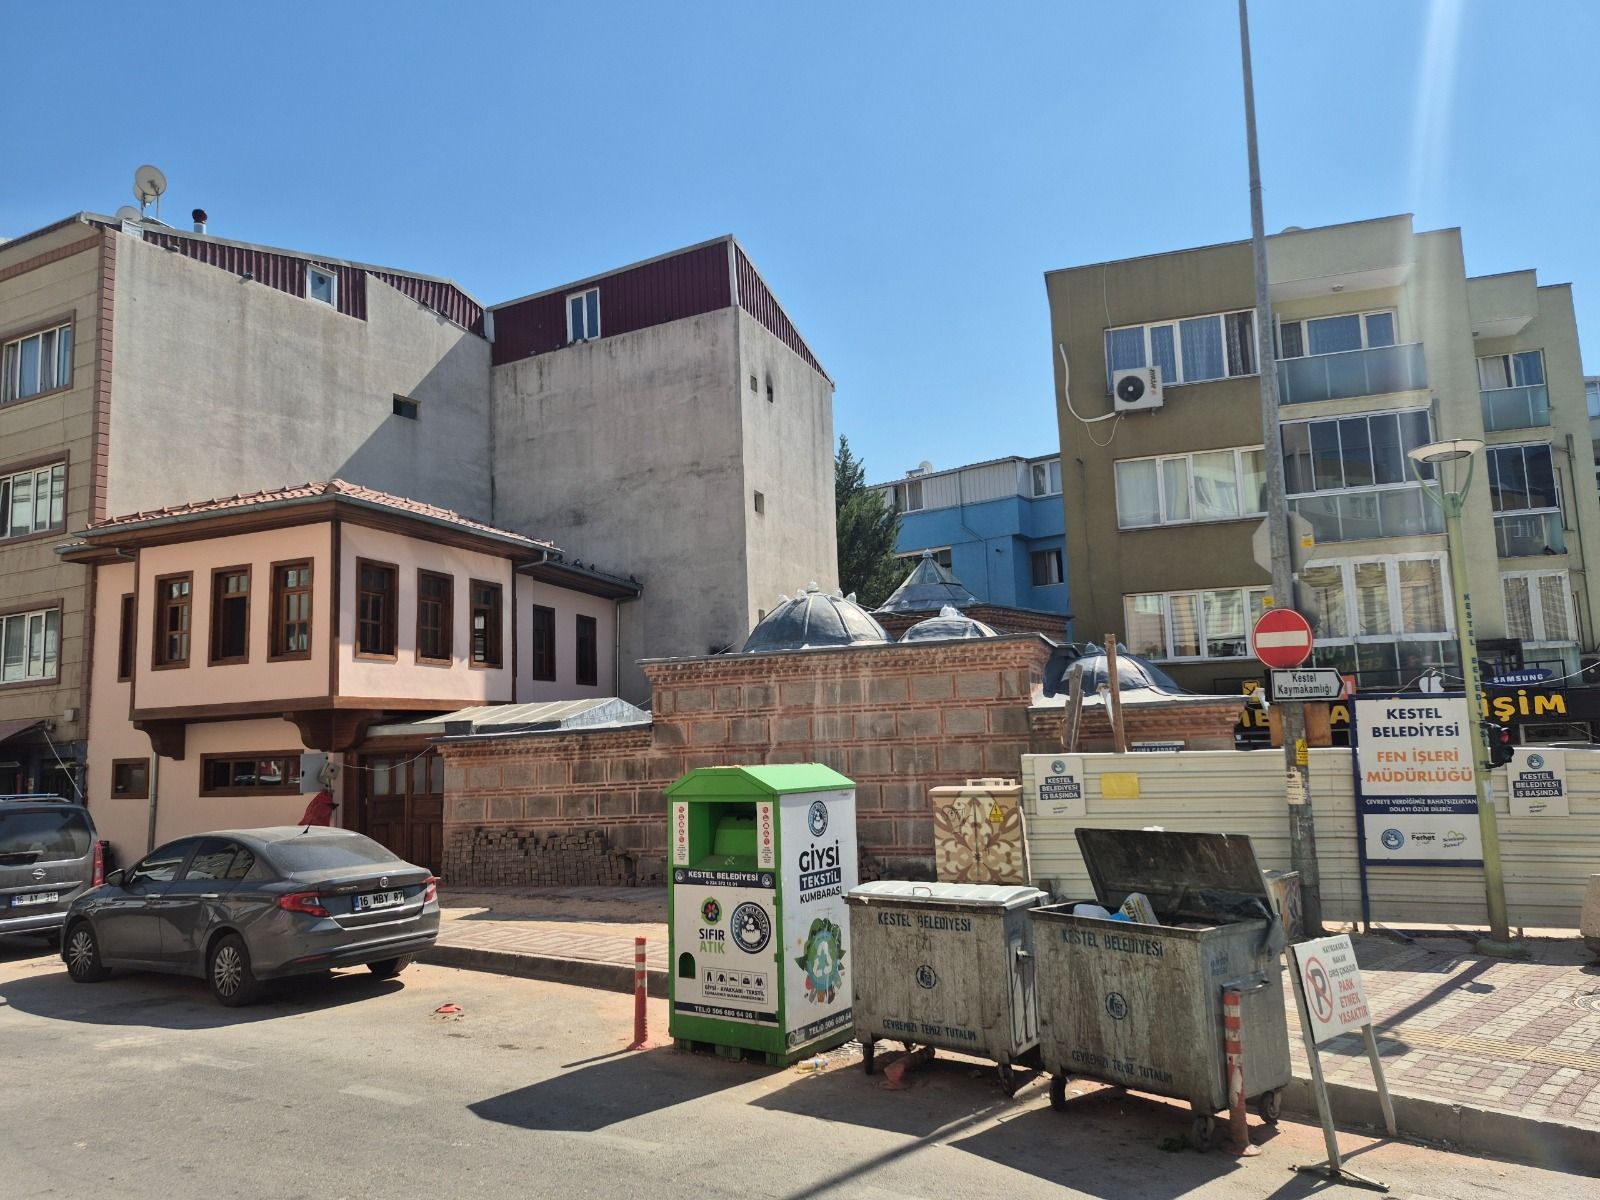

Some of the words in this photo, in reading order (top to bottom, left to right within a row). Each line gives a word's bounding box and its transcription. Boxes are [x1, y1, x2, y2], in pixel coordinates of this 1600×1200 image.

[1291, 672, 1317, 683] Kestel
[1493, 673, 1544, 683] SAMSUNG
[1278, 683, 1332, 696] Kaymakamlığı
[1386, 707, 1442, 720] KESTEL
[1372, 722, 1460, 738] BELEDİYESİ
[1377, 750, 1407, 763] FEN
[1412, 748, 1459, 765] İŞLERİ
[1366, 767, 1473, 783] MÜDÜRLÜĞÜ
[799, 839, 840, 873] GİYSİ
[688, 870, 715, 879] KESTEL
[716, 871, 759, 882] BELEDİYESİ
[801, 868, 840, 889] TEKSTİL
[360, 896, 369, 906] 16
[373, 893, 389, 904] MBY
[393, 892, 403, 901] 87
[800, 886, 842, 904] KUMBARASI
[878, 912, 912, 928] KESTEL
[917, 915, 971, 932] BELEDİYESİ
[699, 928, 725, 941] SIFIR
[700, 941, 726, 955] ATIK
[1062, 929, 1099, 948] KESTEL
[1104, 934, 1164, 957] BELEDİYESİ
[1338, 979, 1355, 993] PARK
